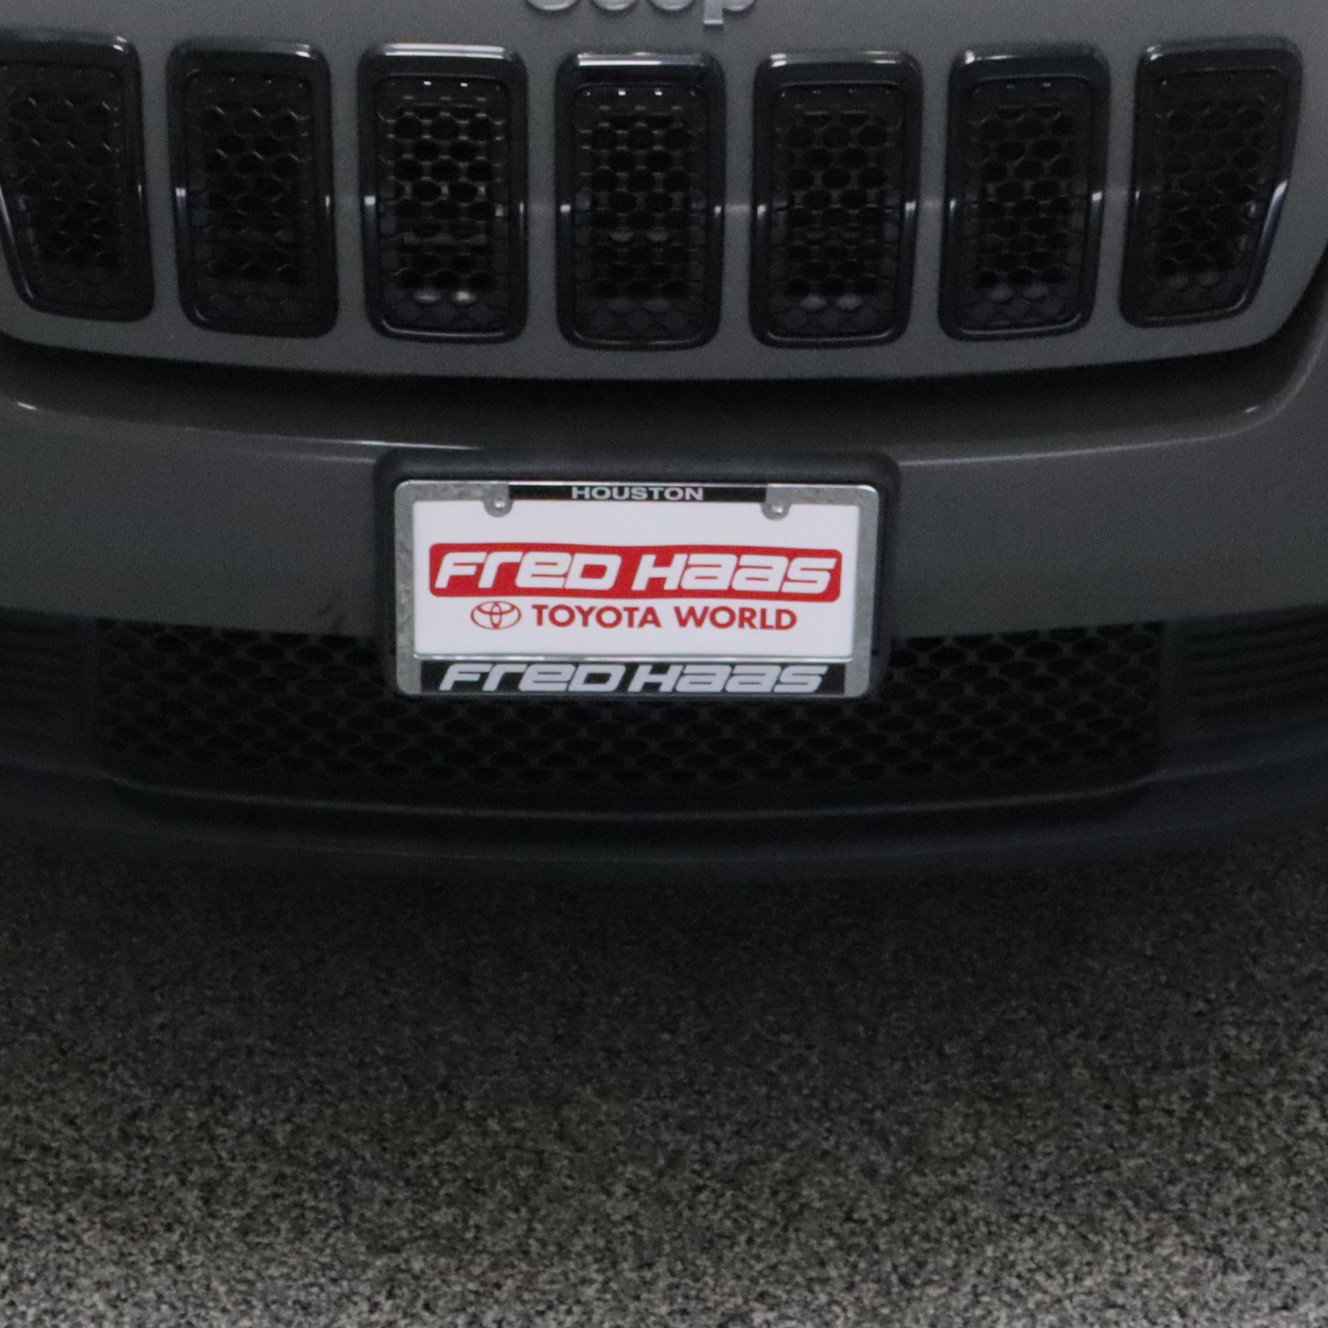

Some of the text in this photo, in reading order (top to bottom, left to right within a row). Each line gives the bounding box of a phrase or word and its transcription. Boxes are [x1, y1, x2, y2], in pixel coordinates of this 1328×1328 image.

[572, 486, 704, 501] HOUSTON
[532, 604, 798, 631] TOYOTA WORLD
